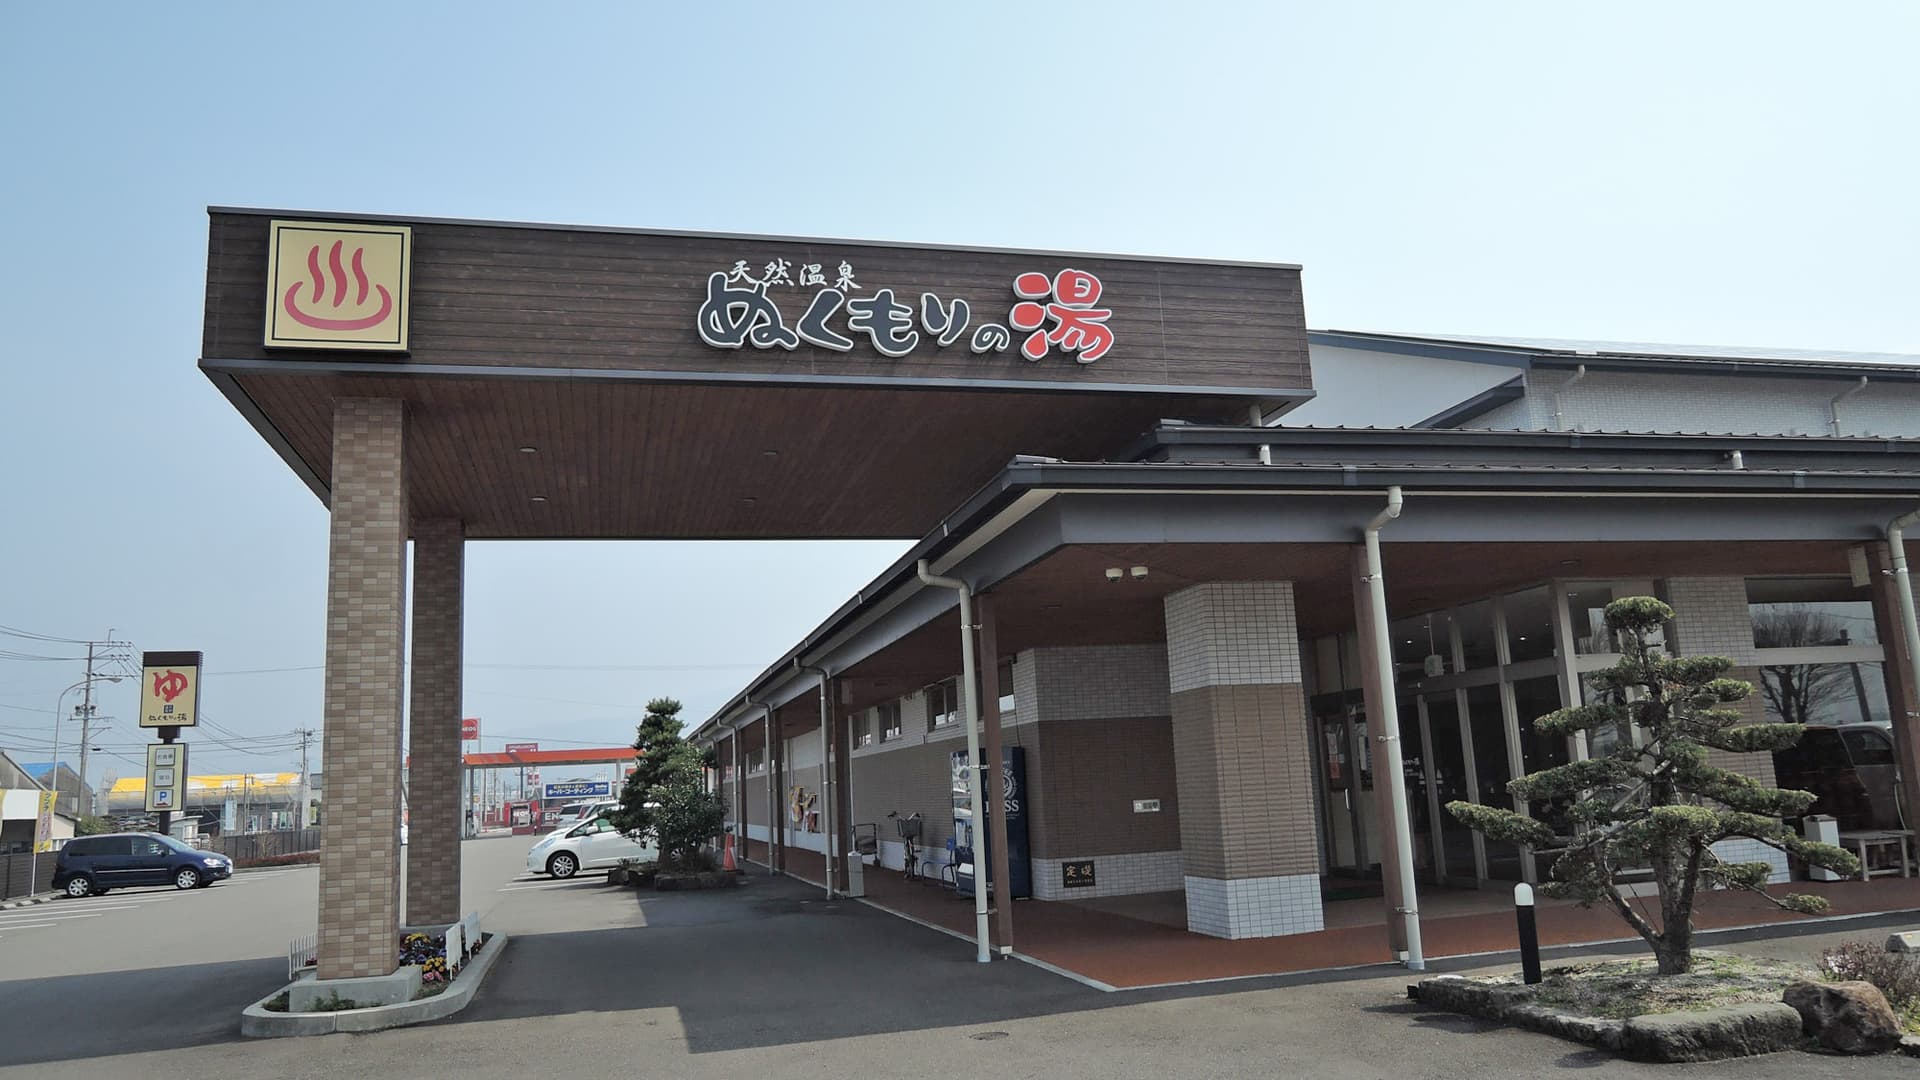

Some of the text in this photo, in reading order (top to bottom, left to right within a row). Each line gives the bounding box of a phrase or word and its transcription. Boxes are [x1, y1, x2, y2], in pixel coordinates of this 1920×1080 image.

[728, 258, 862, 291] 天然温泉
[697, 269, 1115, 364] ぬくもりの湯
[153, 669, 188, 703] ゆ
[159, 791, 167, 801] P
